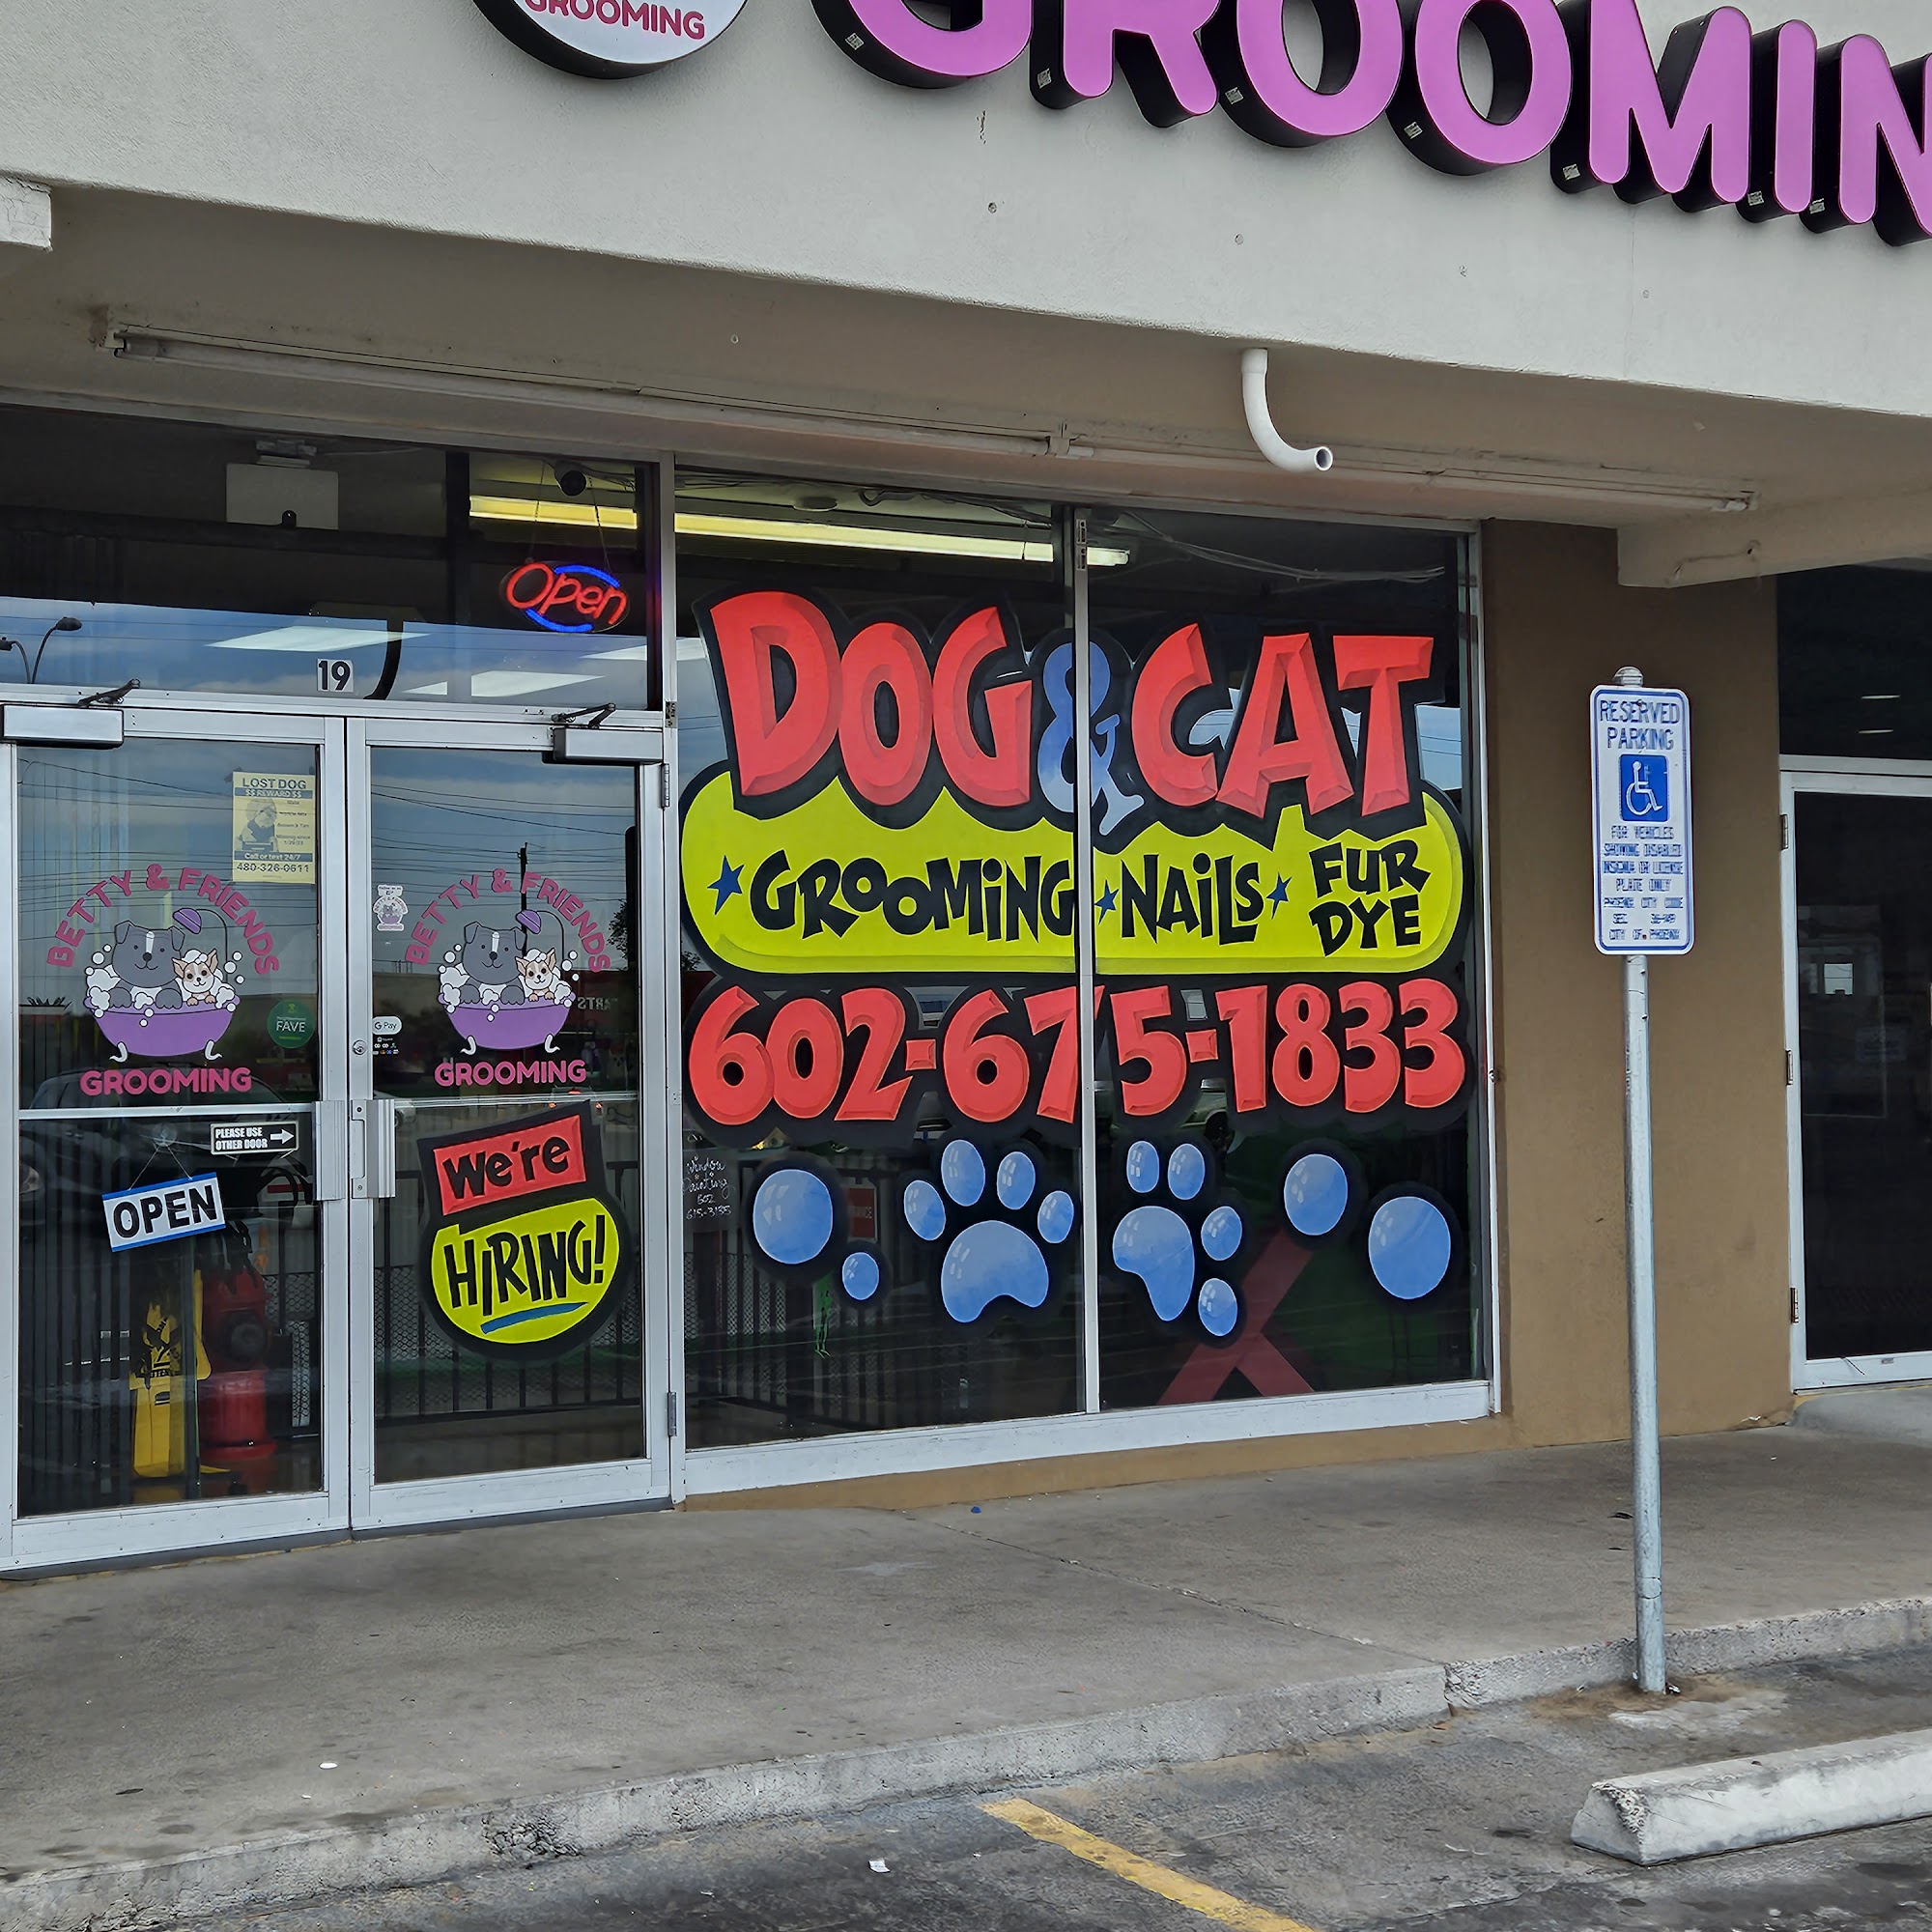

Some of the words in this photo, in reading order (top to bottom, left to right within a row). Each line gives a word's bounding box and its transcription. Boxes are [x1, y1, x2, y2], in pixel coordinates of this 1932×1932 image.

[505, 562, 627, 625] Open
[318, 661, 351, 691] 19
[710, 590, 1032, 807] DOG
[1037, 641, 1144, 836] &
[1132, 623, 1434, 818] CAT
[1600, 700, 1681, 724] RESERVED
[1607, 726, 1675, 750] PARKING
[242, 778, 275, 788] LOST
[278, 779, 306, 789] DOG
[1309, 839, 1432, 898] FUR
[46, 869, 132, 967] BETTY
[146, 864, 170, 891] &
[178, 867, 280, 975] FRIENDS
[405, 874, 480, 965] BETTY
[491, 868, 513, 893] &
[520, 871, 611, 973] FRIENDS
[1309, 895, 1422, 956] DYE
[276, 1020, 306, 1033] FAVE
[384, 1021, 397, 1031] Pay
[689, 978, 1465, 1126] 602-675-1833
[80, 1067, 251, 1095] GROOMING
[435, 1060, 586, 1087] GROOMING
[215, 1128, 245, 1139] PLEASE
[246, 1127, 263, 1137] USE
[215, 1140, 242, 1151] OTHER
[244, 1138, 268, 1150] DOOR
[442, 1136, 570, 1200] We're
[113, 1185, 217, 1237] OPEN
